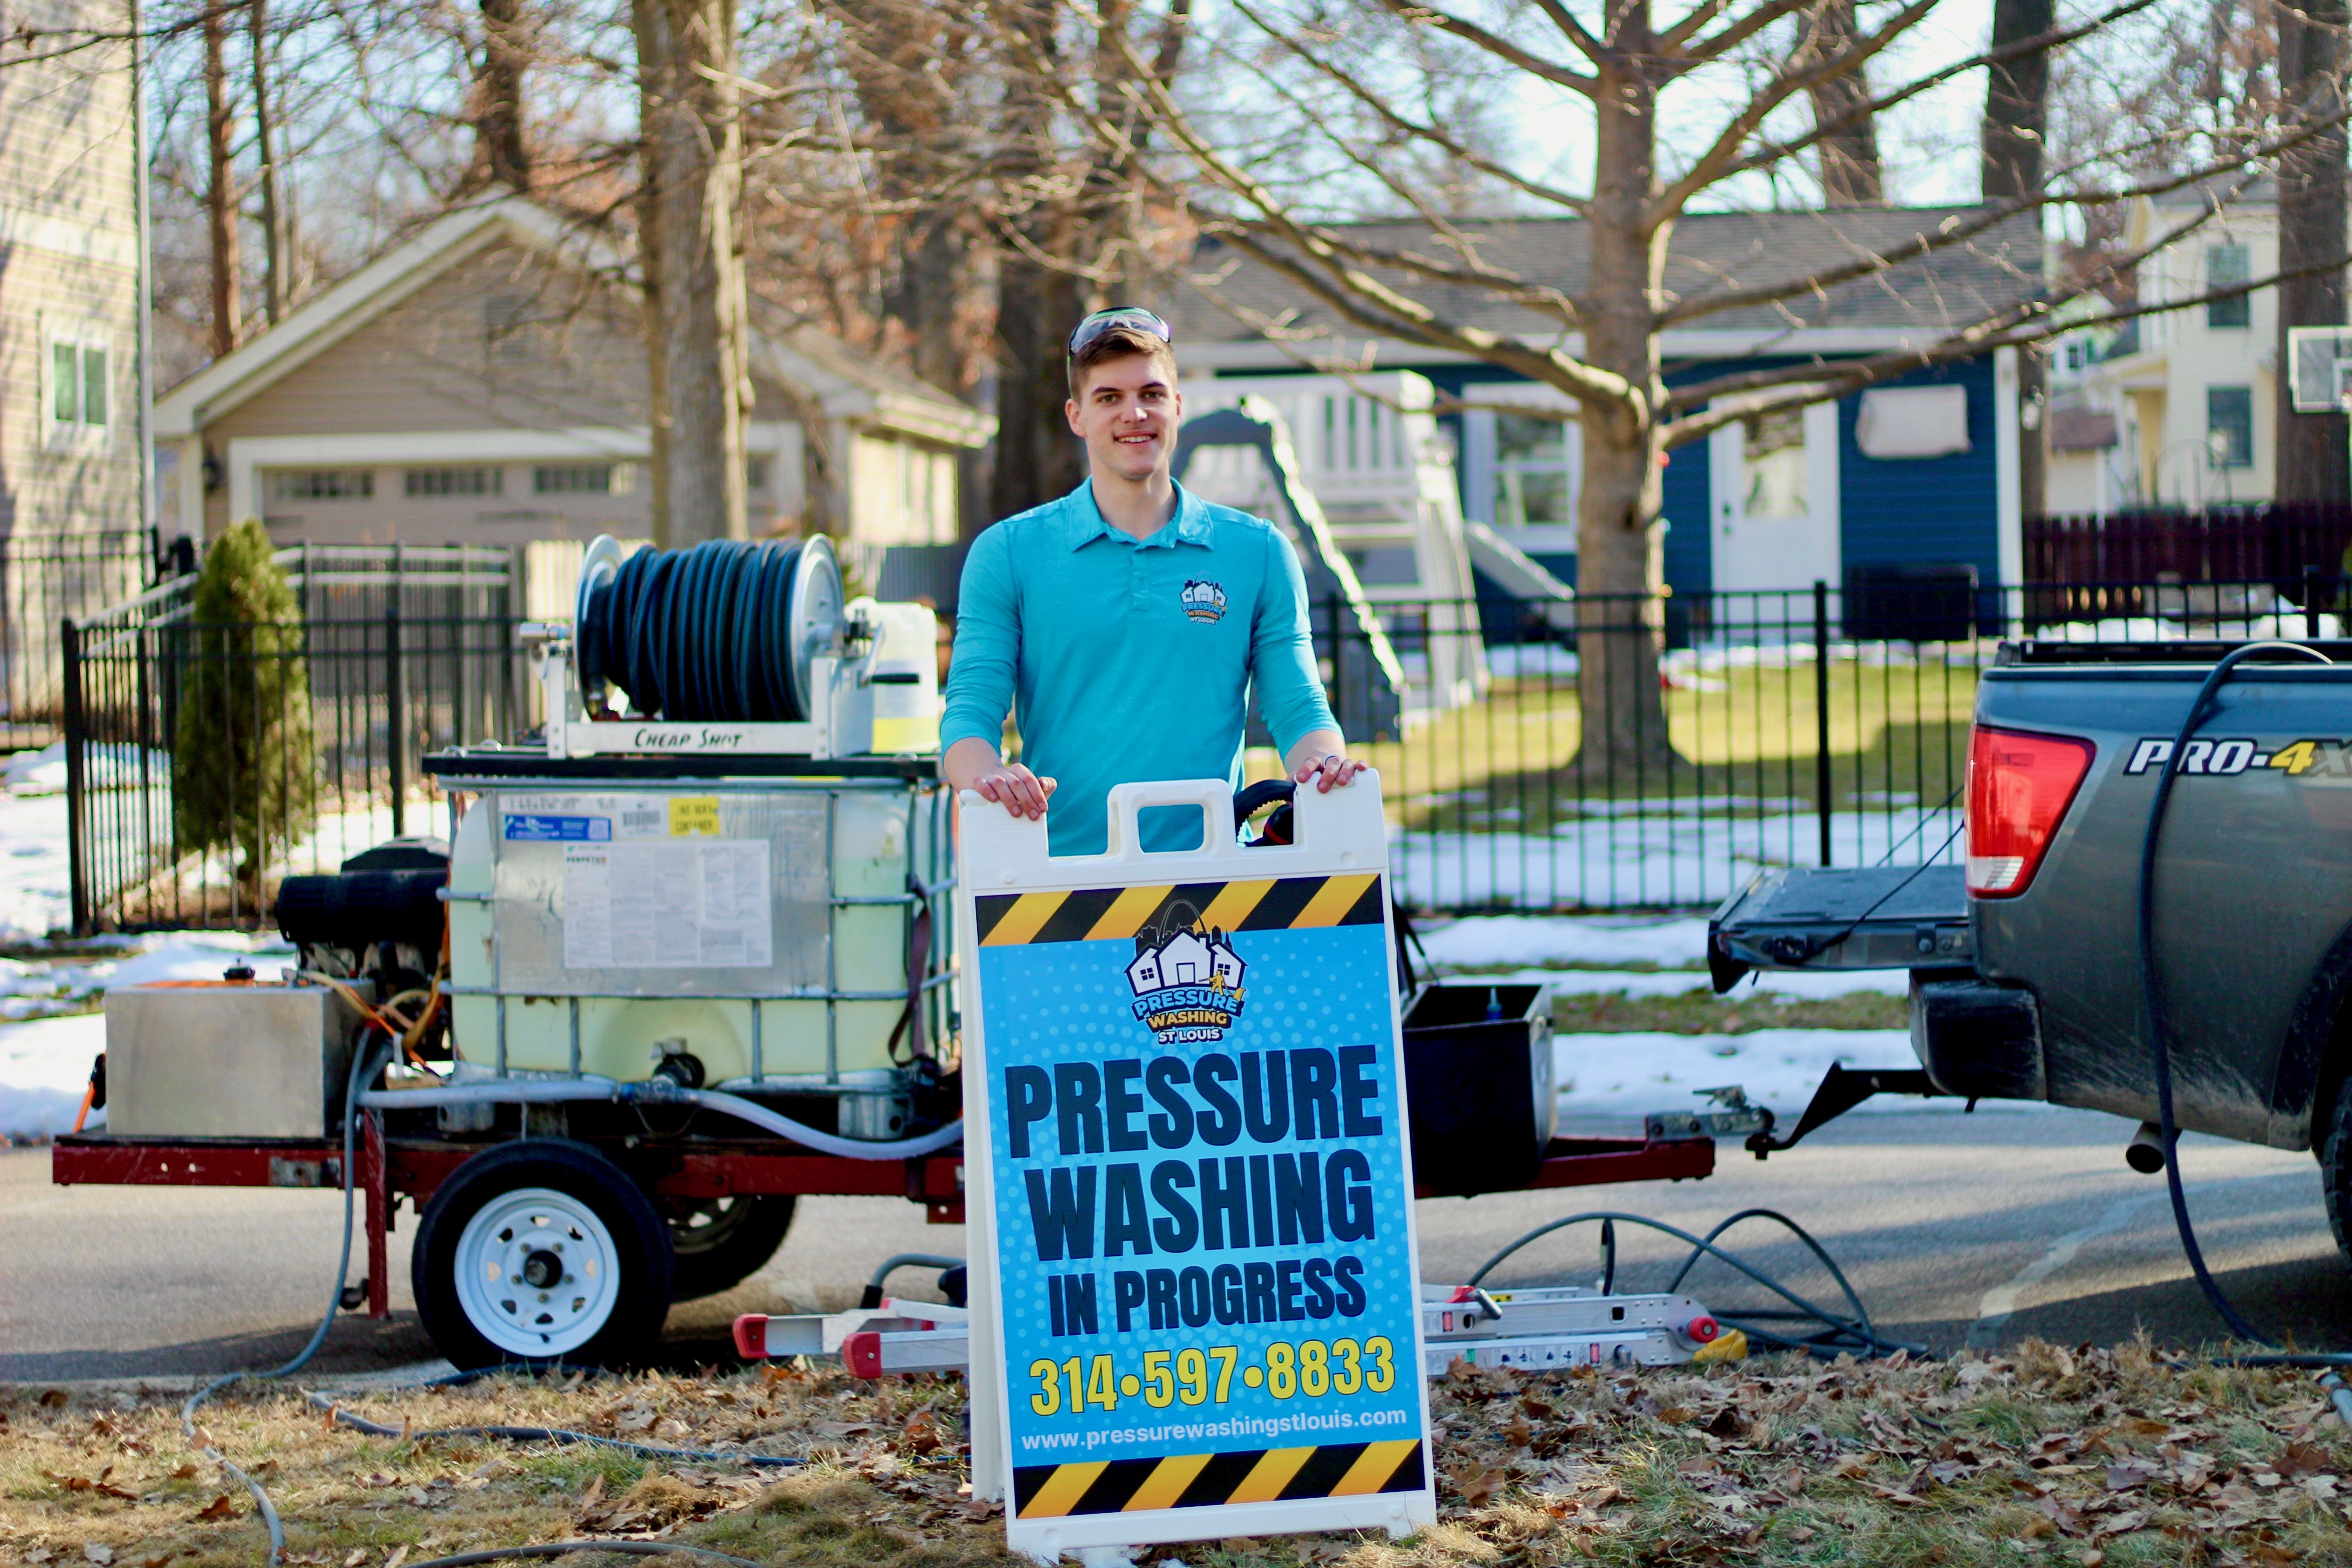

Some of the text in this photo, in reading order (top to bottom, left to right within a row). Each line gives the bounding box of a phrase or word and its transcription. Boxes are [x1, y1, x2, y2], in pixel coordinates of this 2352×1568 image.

[1182, 603, 1223, 616] PRESSURE
[1187, 611, 1219, 619] WASHING
[635, 728, 743, 748] CHEAP SHOT
[1133, 990, 1239, 1017] PRESSURE
[1147, 1010, 1228, 1029] WASHING
[1158, 1029, 1220, 1043] ST LOUIS
[1005, 1044, 1383, 1158] PRESSURE
[1024, 1148, 1375, 1261] WASHING
[1048, 1255, 1367, 1337] IN PROGRESS
[1022, 1409, 1406, 1450] www.pressurewashingstlouis.com
